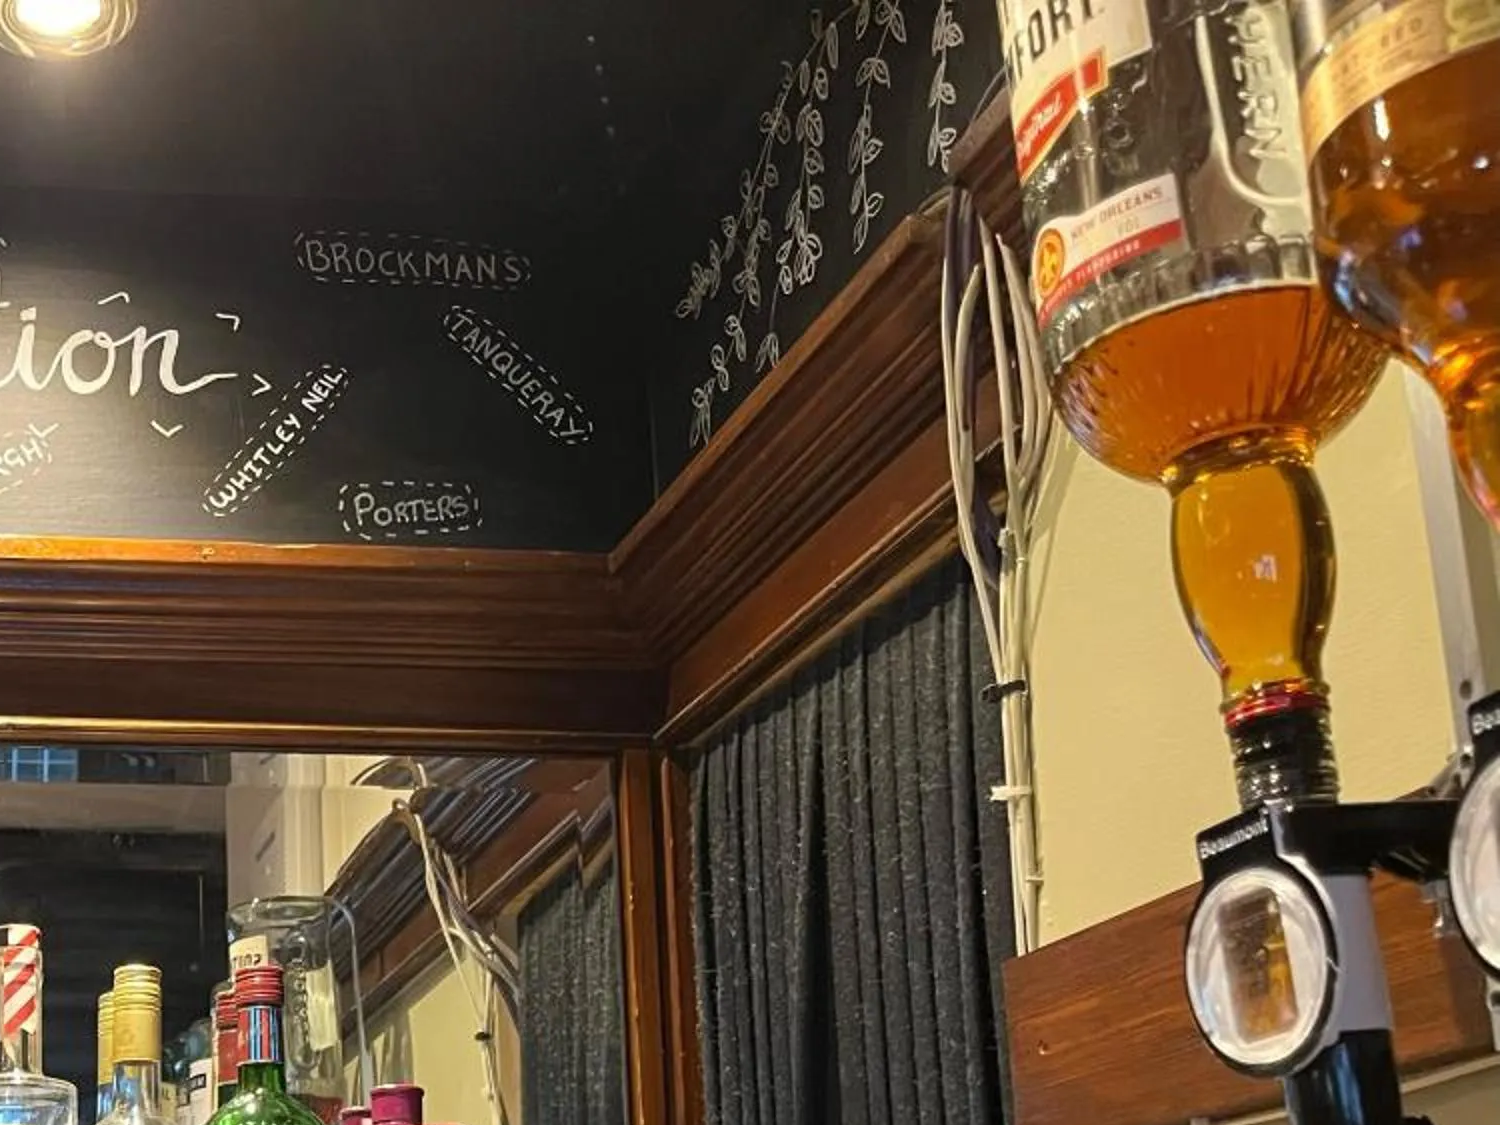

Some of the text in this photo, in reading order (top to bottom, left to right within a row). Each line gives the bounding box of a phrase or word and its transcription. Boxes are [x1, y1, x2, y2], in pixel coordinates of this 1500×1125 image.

[1100, 187, 1162, 223] ORLEANS
[306, 240, 523, 283] BROCKMANS
[449, 314, 585, 438] TANQUERAY
[209, 369, 344, 509] WHITLEY NEIL
[353, 492, 469, 527] PORTERS
